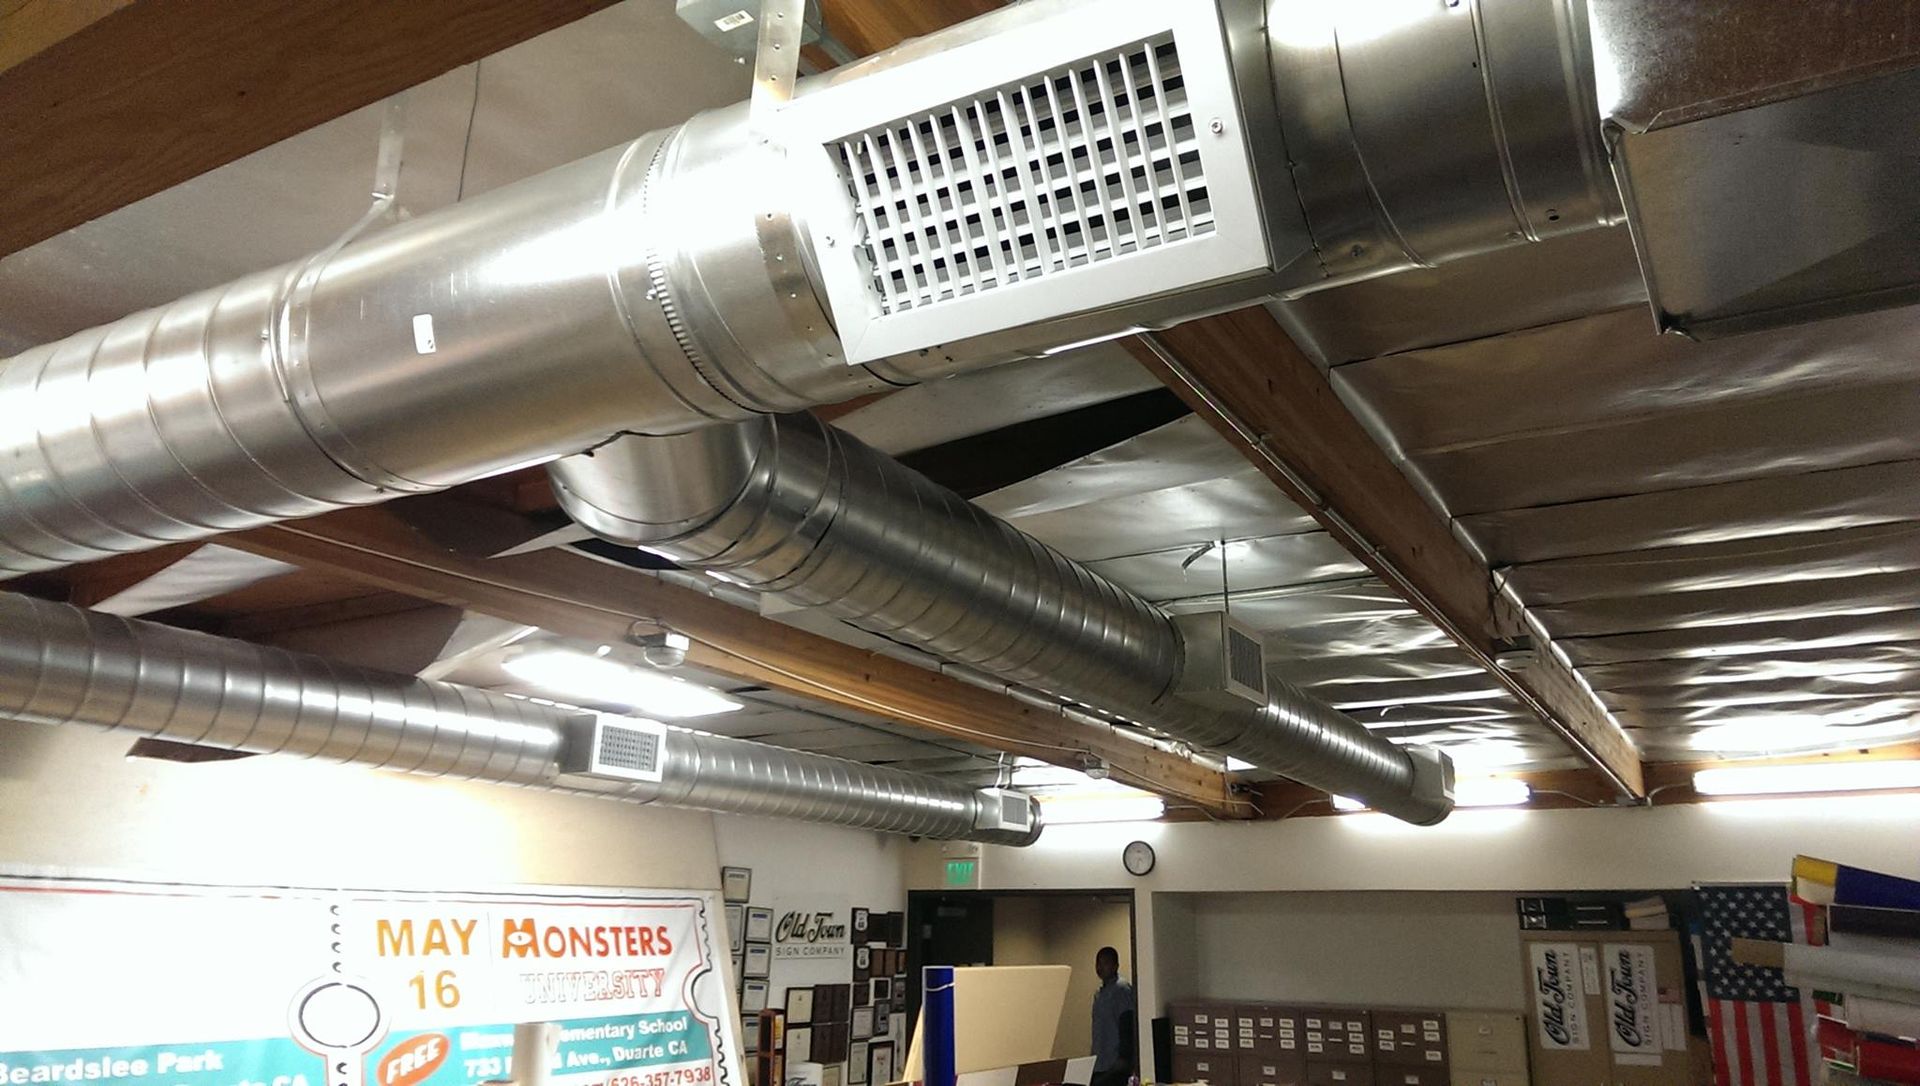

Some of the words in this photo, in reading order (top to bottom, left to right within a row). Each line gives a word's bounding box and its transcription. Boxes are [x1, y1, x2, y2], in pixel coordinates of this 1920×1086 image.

[376, 918, 478, 957] MAY
[502, 918, 673, 958] MONSTERS
[775, 911, 810, 943] Old
[807, 911, 845, 943] Town
[776, 946, 799, 956] SIGN
[803, 946, 845, 956] COMPANY
[409, 970, 461, 1010] 16
[519, 968, 665, 1004] UNIVERSITY
[1537, 950, 1565, 1004] Town
[1563, 952, 1576, 1009] COMPANY
[1609, 950, 1638, 1004] Town
[1637, 952, 1649, 1010] COMPANY
[558, 1023, 635, 1040] ementary
[638, 1016, 688, 1035] School
[1542, 1000, 1570, 1045] Old
[1614, 1000, 1642, 1047] Old
[157, 1049, 224, 1075] Park
[385, 1036, 441, 1085] FREE
[612, 1044, 664, 1062] Duarte
[668, 1040, 688, 1056] CA
